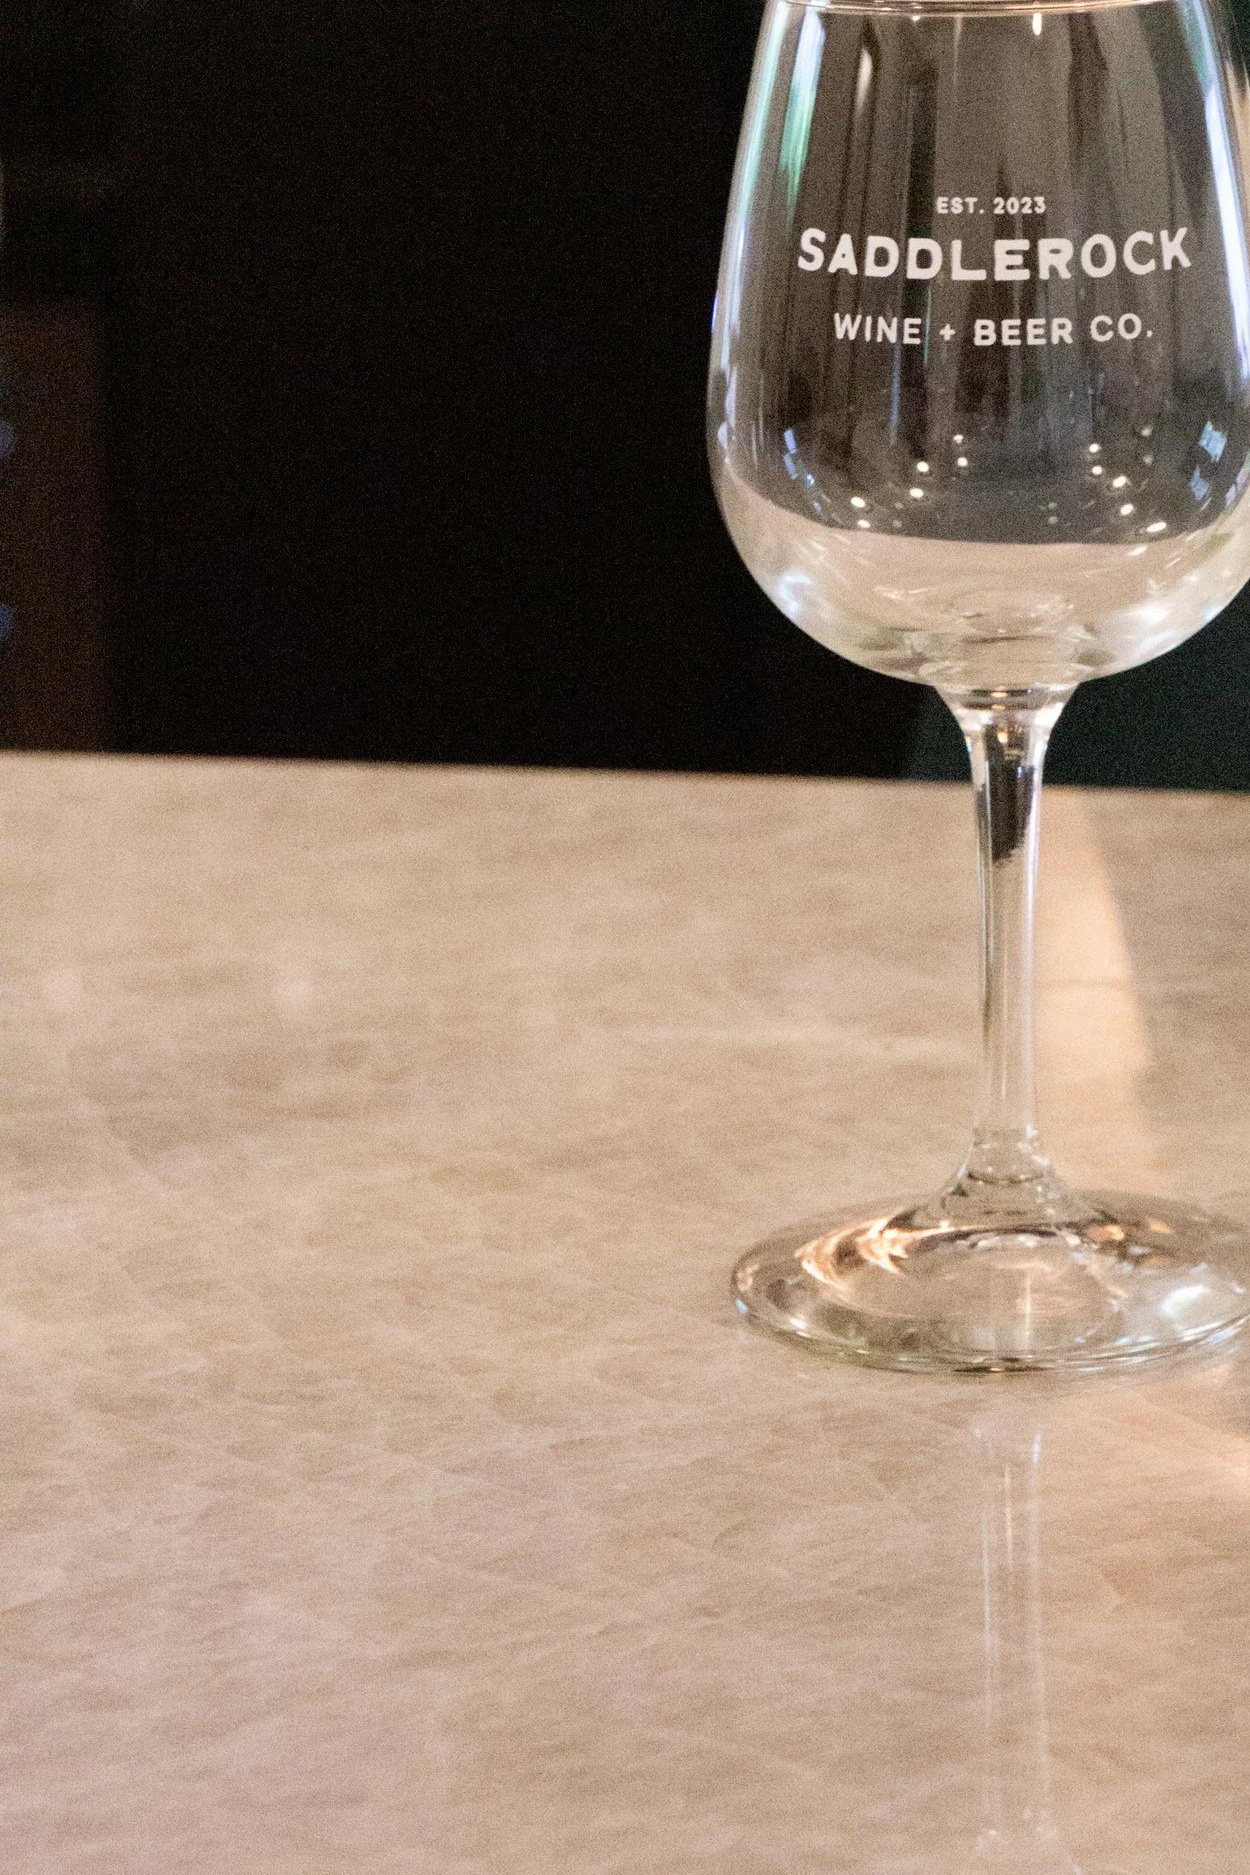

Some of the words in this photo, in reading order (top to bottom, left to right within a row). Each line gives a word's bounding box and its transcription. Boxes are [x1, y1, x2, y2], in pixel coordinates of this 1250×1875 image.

[936, 196, 985, 215] EST.
[993, 196, 1047, 215] 2023
[797, 226, 1192, 281] SADDLEROCK
[834, 312, 923, 346] WINE
[938, 324, 957, 342] +
[973, 316, 1074, 347] BEER
[1089, 312, 1154, 342] CO.
